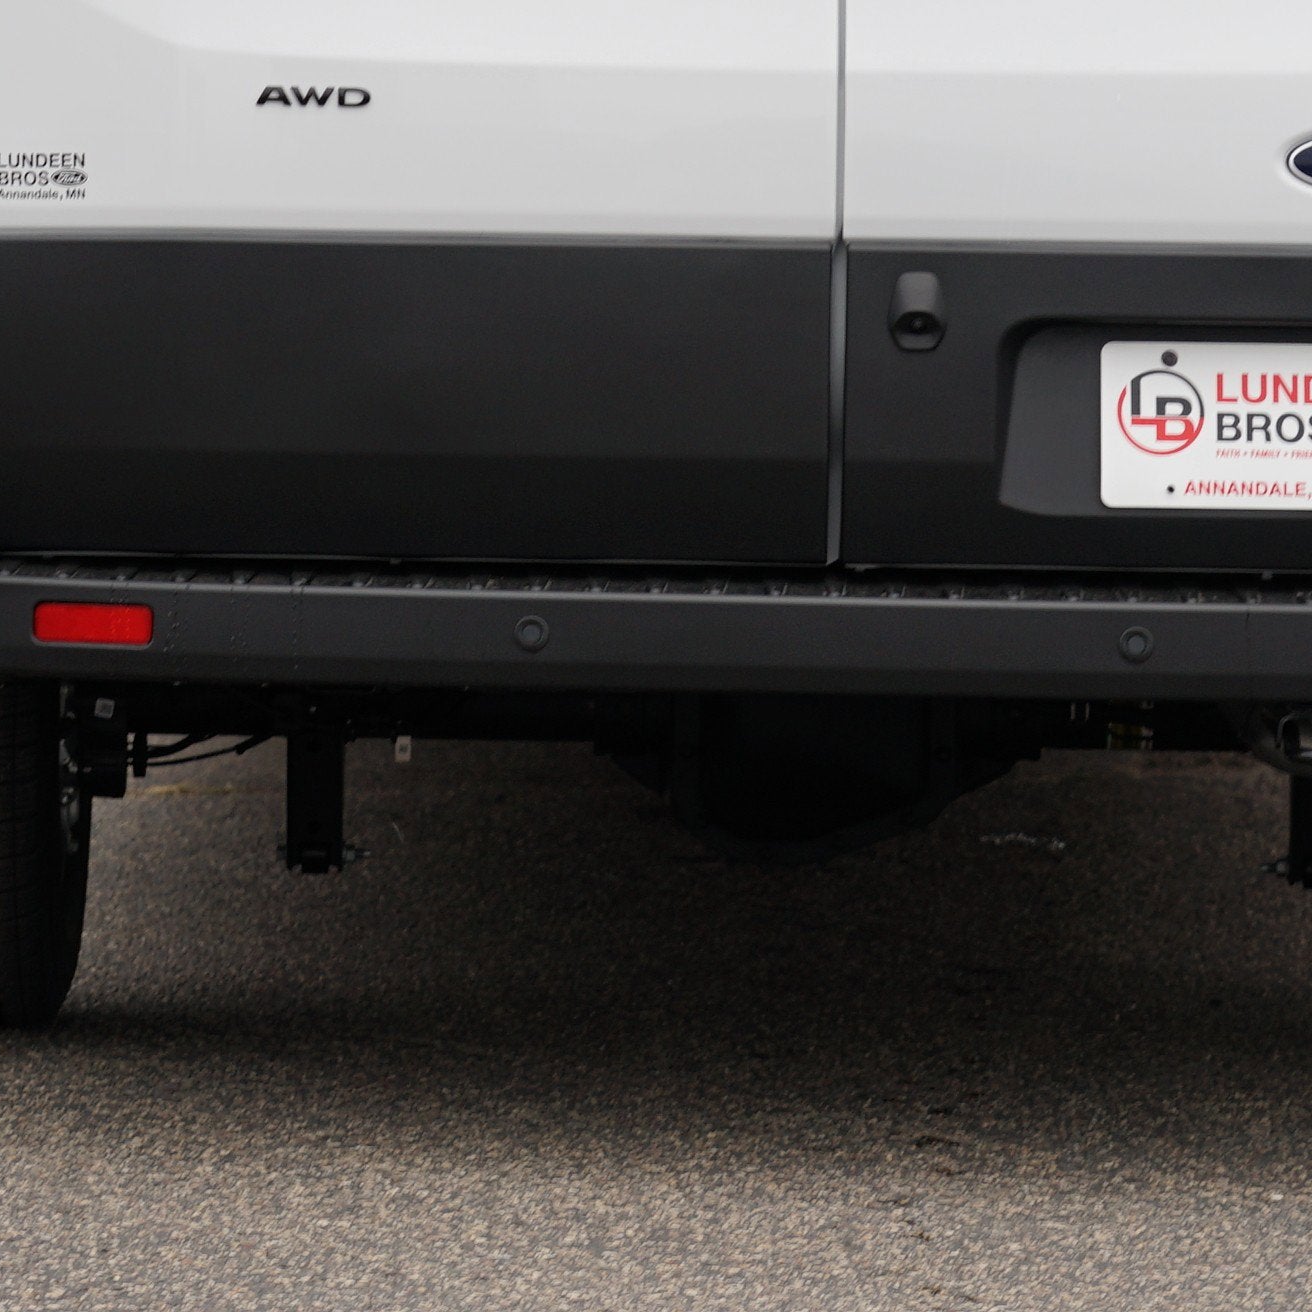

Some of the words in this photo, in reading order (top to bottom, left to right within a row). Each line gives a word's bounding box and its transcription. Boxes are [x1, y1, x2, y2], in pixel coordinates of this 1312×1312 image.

[256, 85, 371, 107] AWD
[66, 189, 86, 200] MN
[1184, 480, 1312, 500] ANNANDALE,
